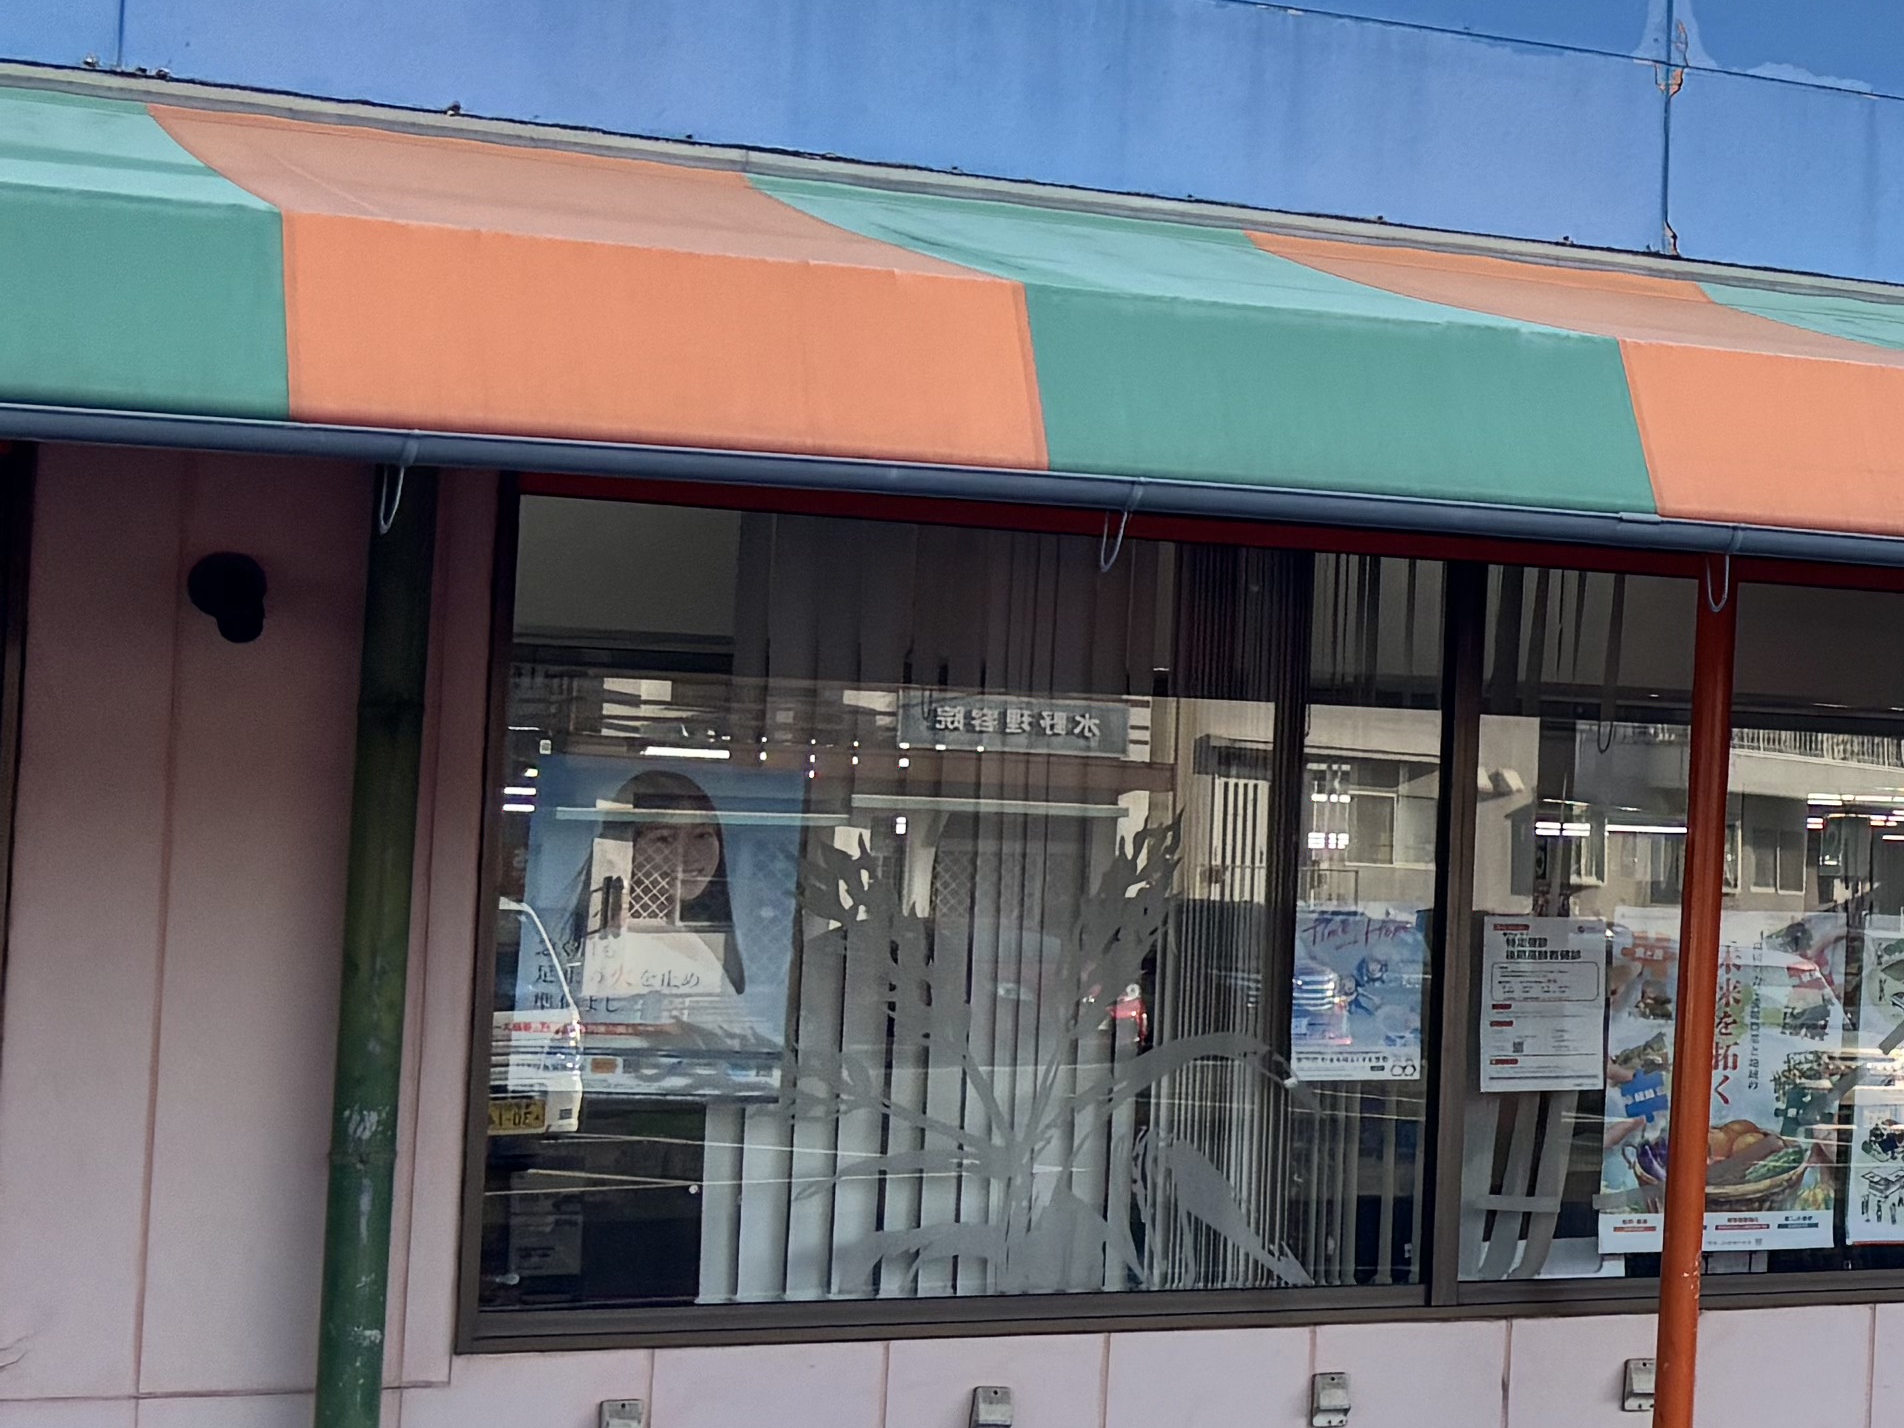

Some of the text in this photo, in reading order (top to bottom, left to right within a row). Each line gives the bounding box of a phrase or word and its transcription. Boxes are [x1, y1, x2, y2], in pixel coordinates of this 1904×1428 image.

[1713, 942, 1741, 1105] 未来を拓く
